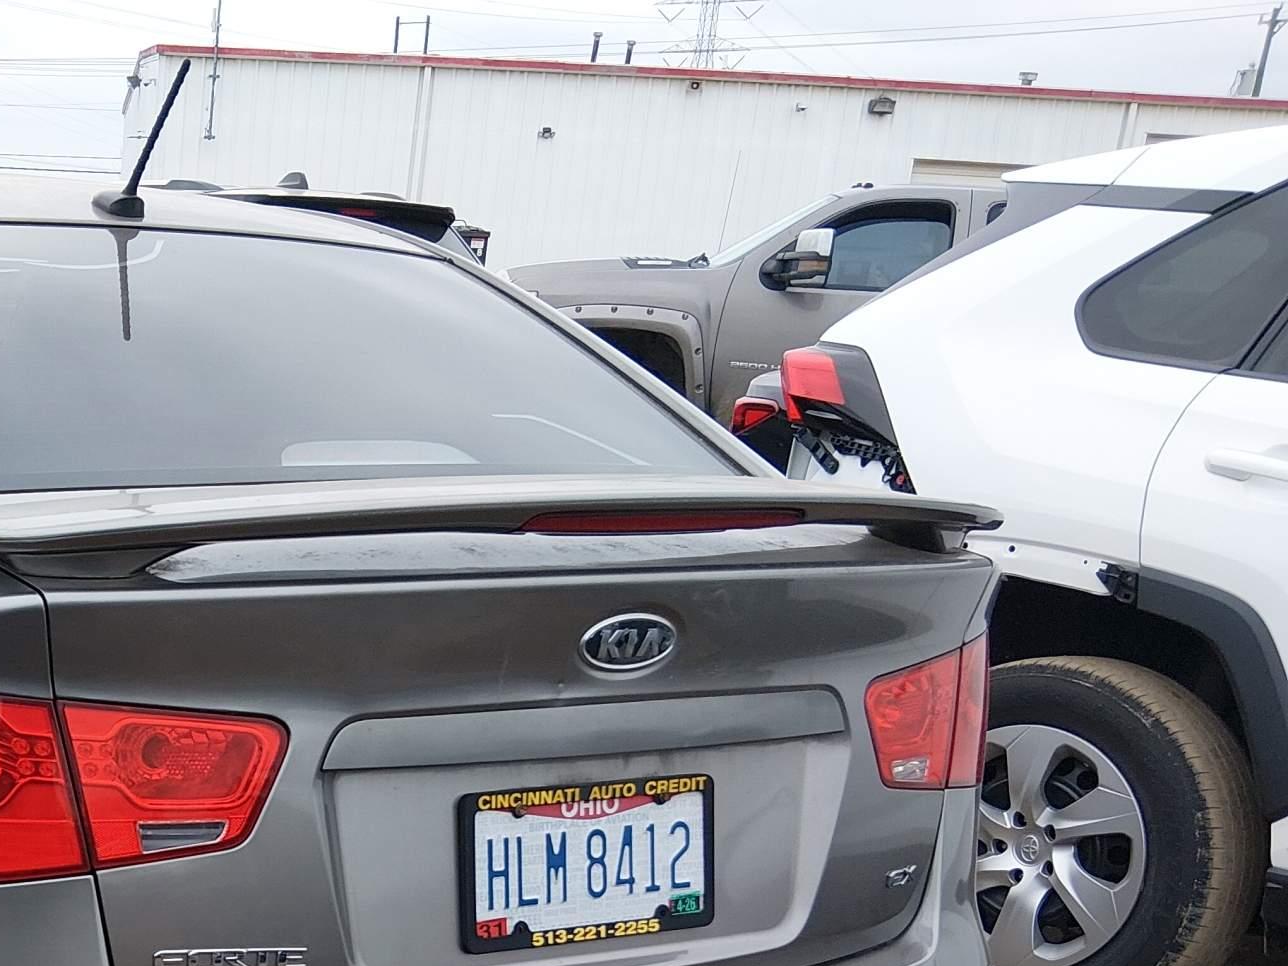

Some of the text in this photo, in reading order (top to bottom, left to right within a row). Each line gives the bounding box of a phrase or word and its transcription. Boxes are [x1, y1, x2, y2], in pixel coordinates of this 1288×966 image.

[478, 777, 707, 810] CINCINNATI AUTO CREDIT
[487, 820, 690, 911] HLM 8412
[532, 918, 660, 946] 513-221-2255
